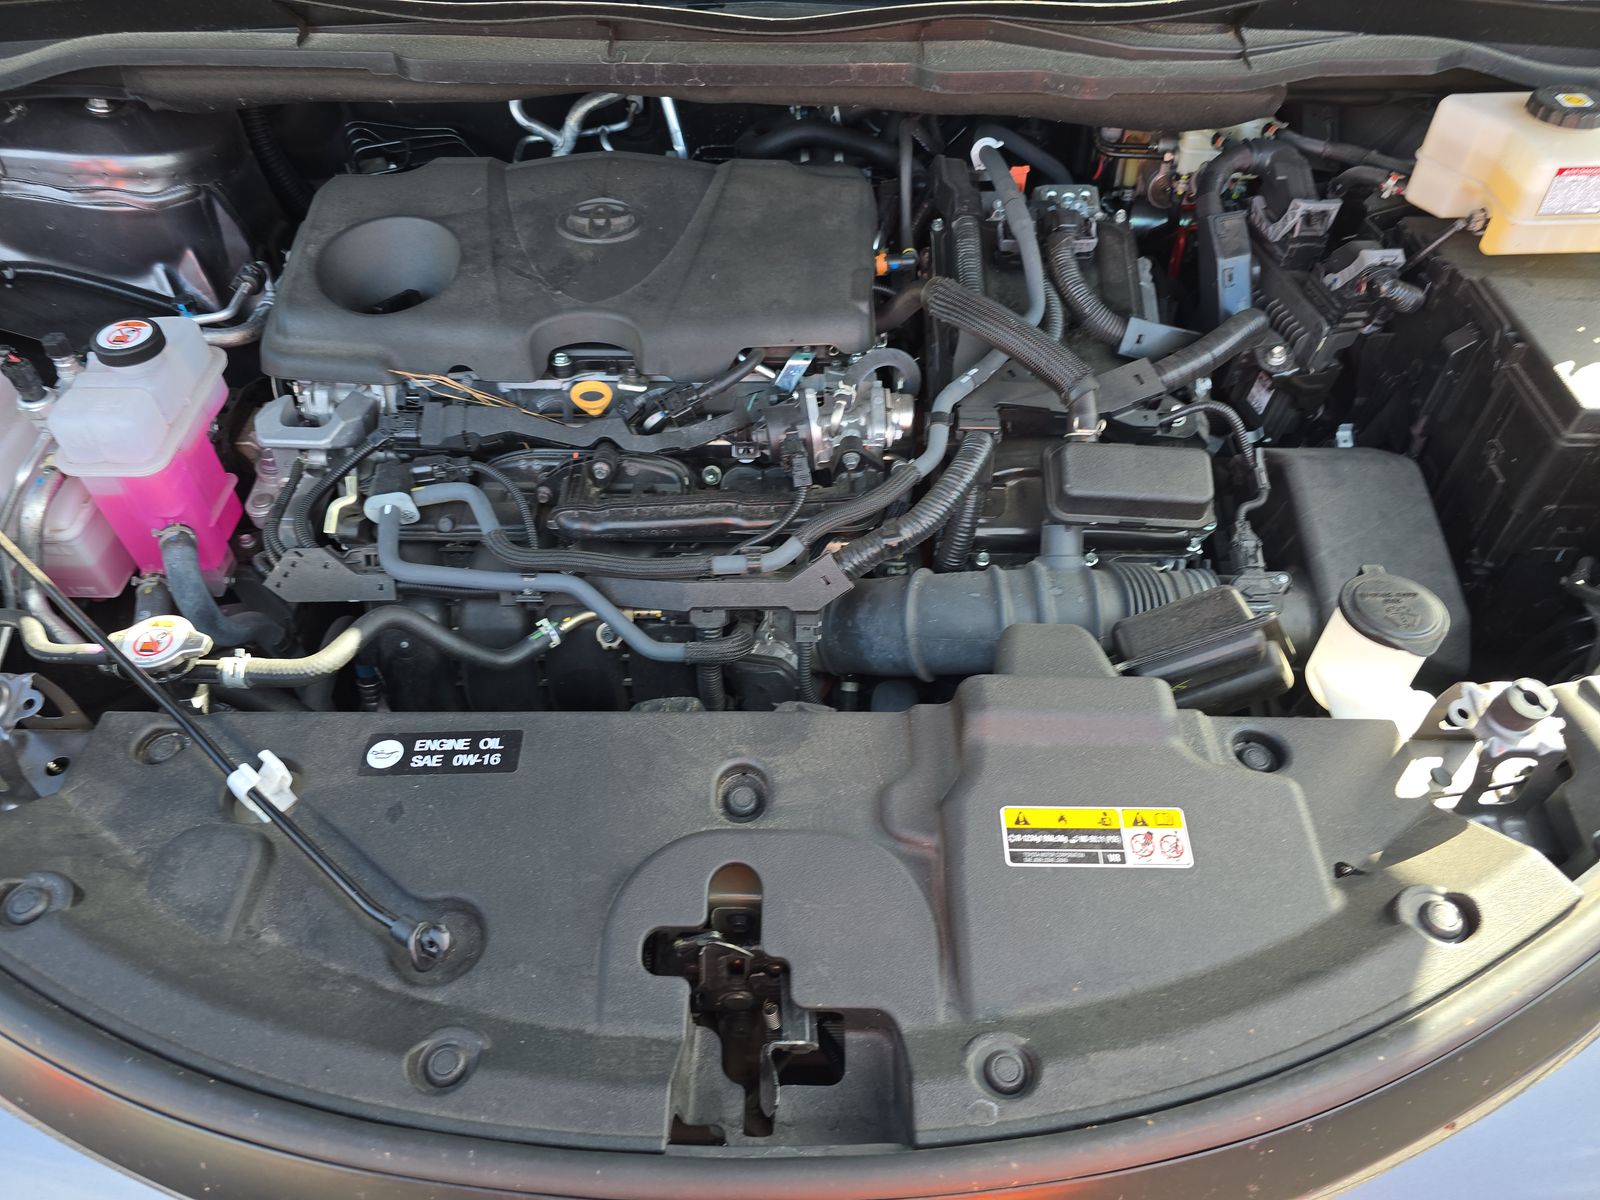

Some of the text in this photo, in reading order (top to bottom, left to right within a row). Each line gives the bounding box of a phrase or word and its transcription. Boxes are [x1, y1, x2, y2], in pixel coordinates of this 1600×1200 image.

[414, 737, 505, 752] ENGINE OIL
[410, 753, 502, 768] SAE 0W-16
